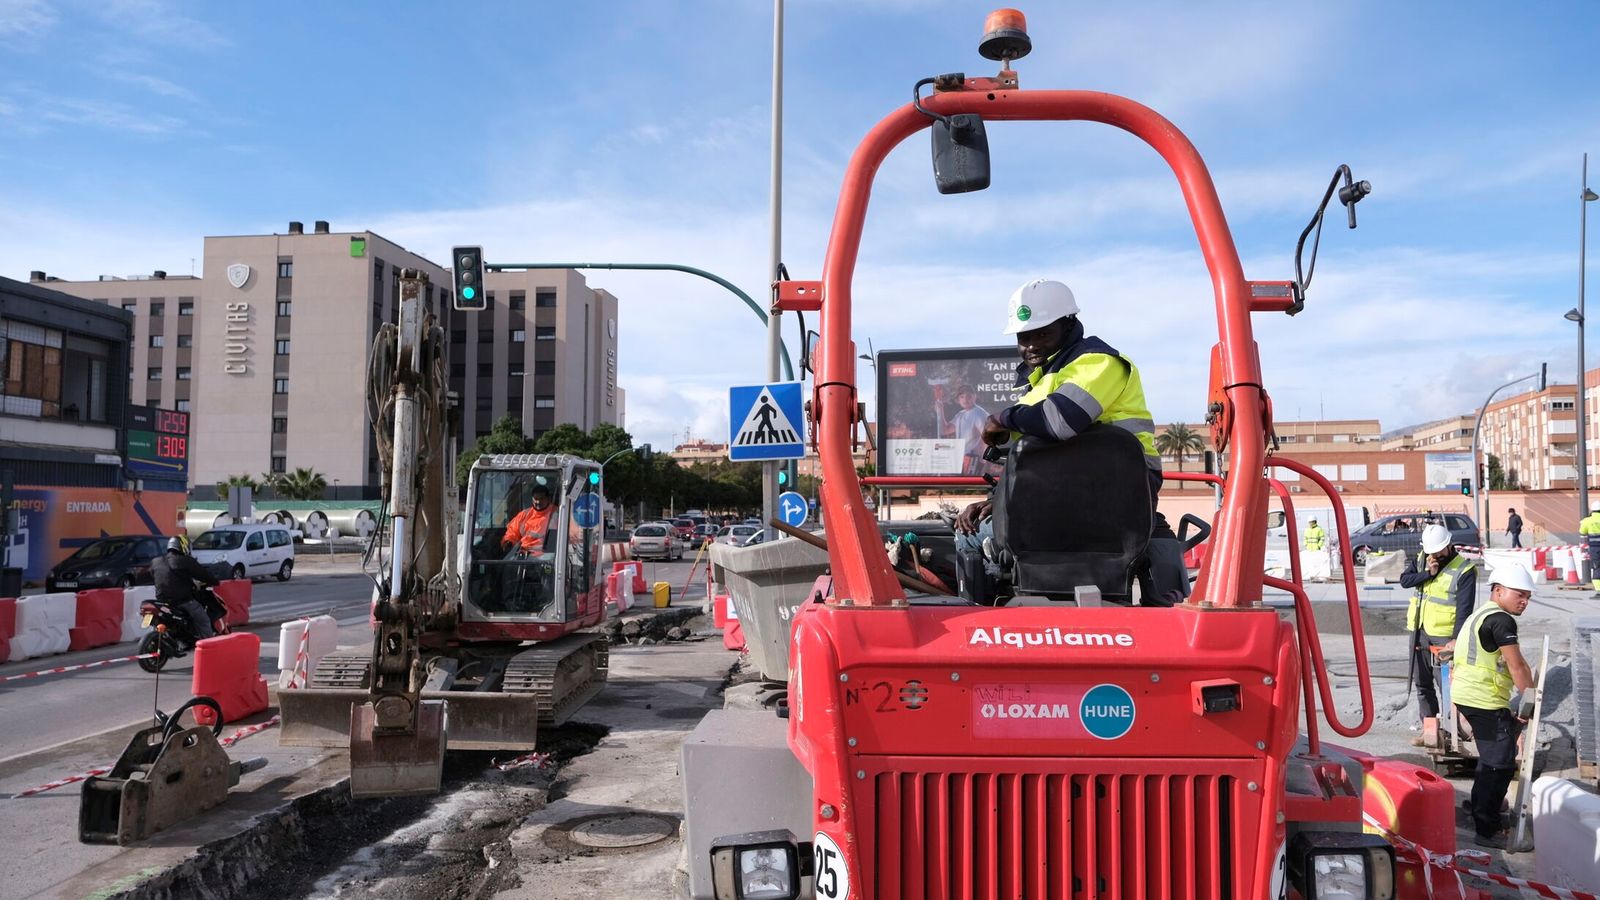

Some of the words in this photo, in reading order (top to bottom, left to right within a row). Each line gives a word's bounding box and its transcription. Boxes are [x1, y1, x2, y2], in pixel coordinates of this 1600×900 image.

[224, 302, 249, 374] CIVITAS
[993, 372, 1015, 382] QUE
[993, 394, 1007, 402] LA
[894, 448, 922, 456] 999€
[66, 501, 112, 513] ENTRADA
[969, 627, 1134, 648] Alquílame
[998, 703, 1070, 719] LOXAM
[1084, 705, 1131, 718] HUNE
[816, 844, 837, 898] 25
